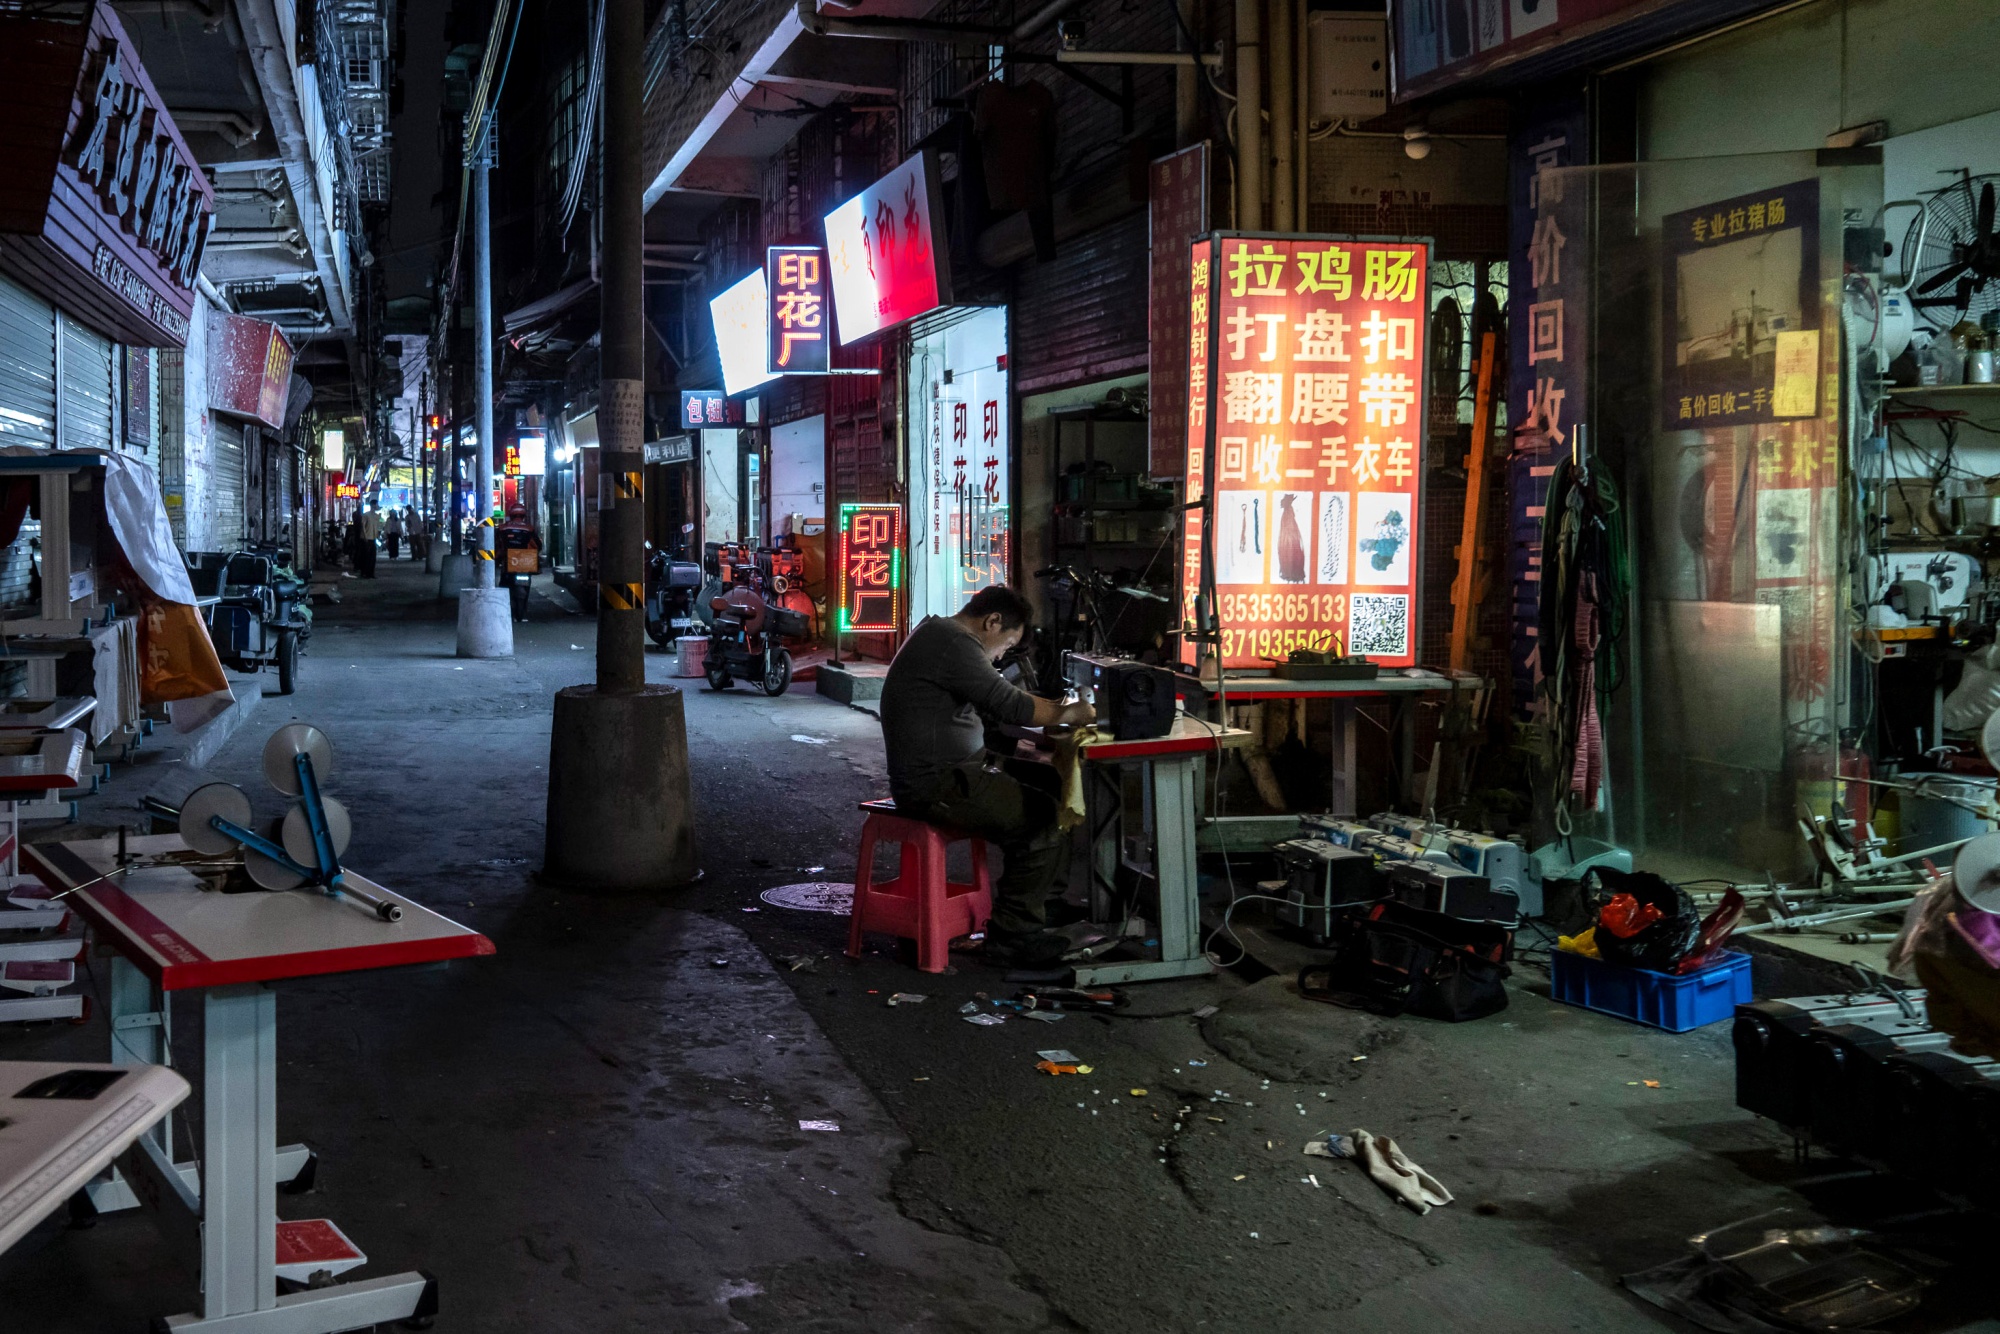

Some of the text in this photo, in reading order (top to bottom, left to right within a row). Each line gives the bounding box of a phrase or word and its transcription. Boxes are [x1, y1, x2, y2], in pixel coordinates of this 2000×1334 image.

[1691, 197, 1786, 242] 专业拉猪肠
[1228, 243, 1418, 303] 拉鸡肠
[777, 253, 821, 367] 印花厂
[1226, 306, 1416, 364] 打盘扣
[1189, 258, 1208, 427] 鸿悦针车行
[1223, 370, 1416, 427] 翻腰带
[983, 400, 1000, 506] 印花
[1219, 434, 1413, 488] 回收二手衣车
[850, 513, 890, 623] 印花厂
[1212, 629, 1343, 658] 3719355021
